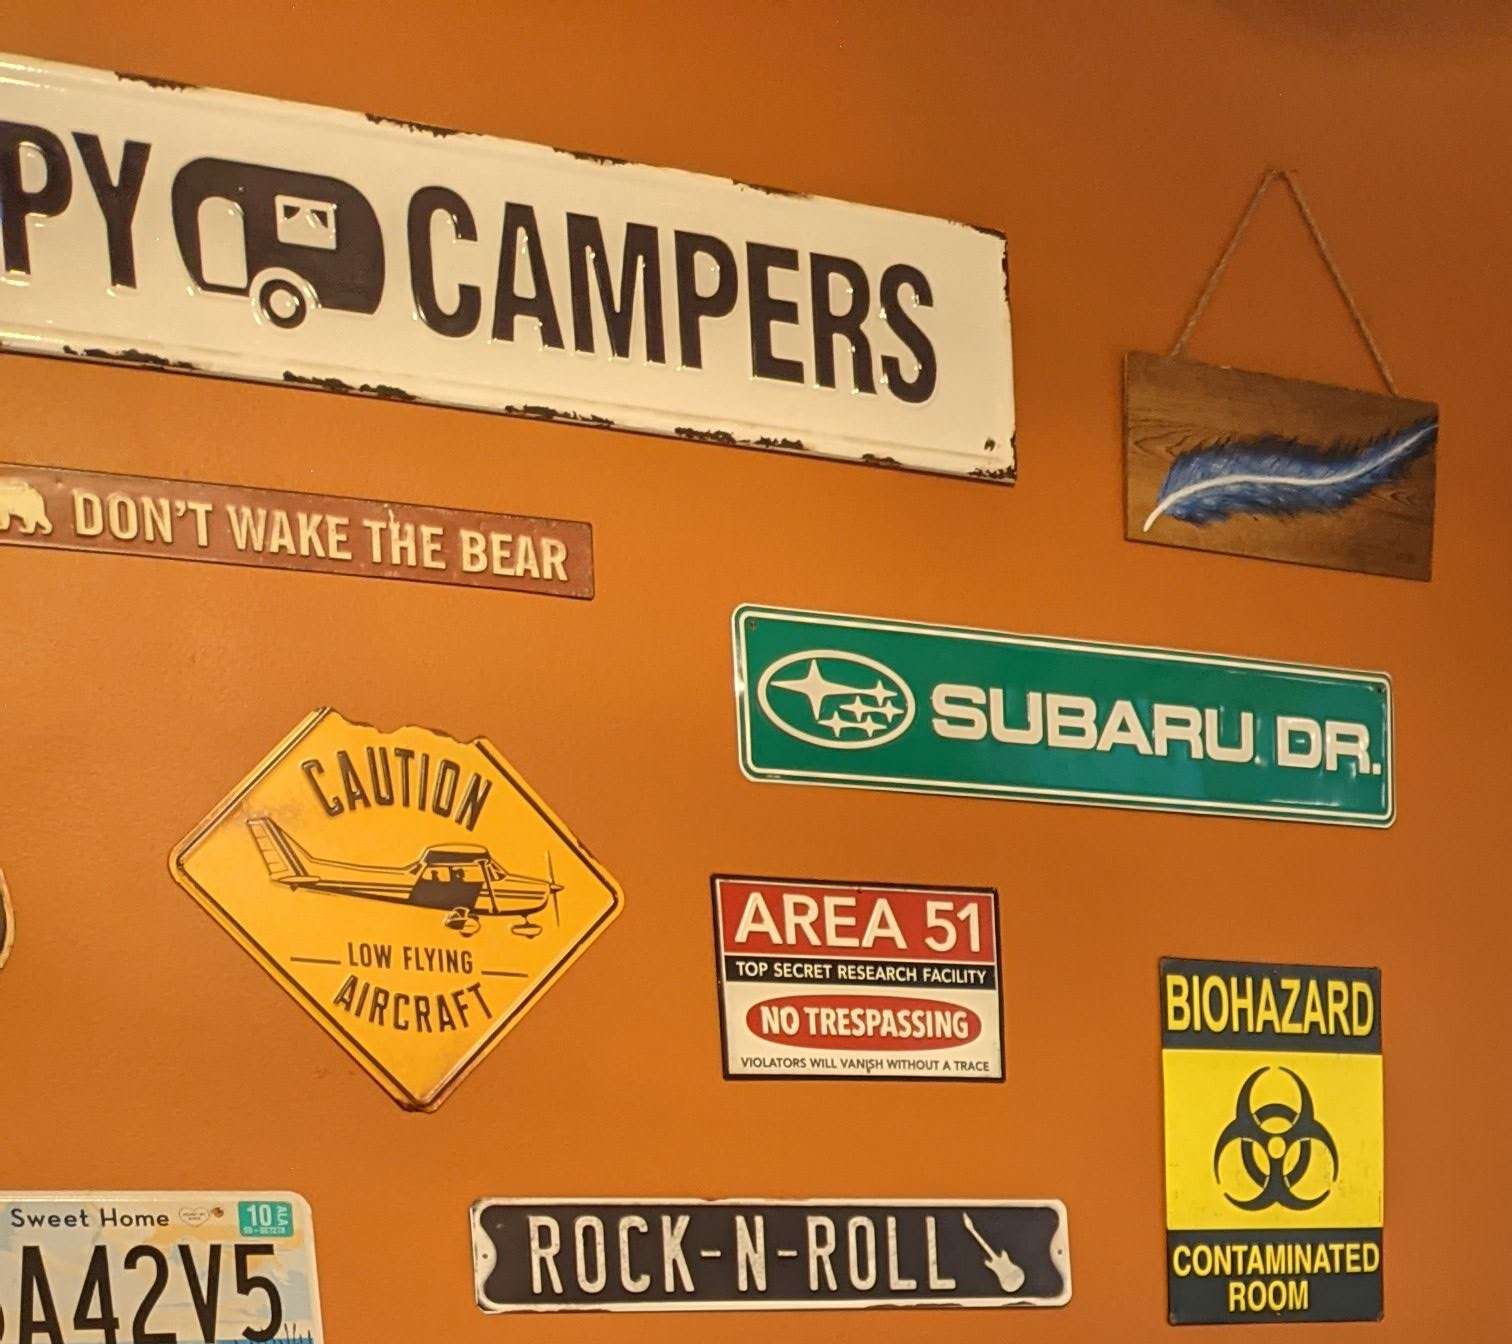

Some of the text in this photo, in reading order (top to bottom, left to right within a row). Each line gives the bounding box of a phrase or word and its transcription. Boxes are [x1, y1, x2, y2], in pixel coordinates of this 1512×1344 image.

[407, 185, 938, 404] CAMPERS
[72, 492, 568, 582] DON'T WAKE THE BEAR
[932, 683, 1382, 775] SUBARU DR.
[301, 746, 493, 832] CAUTION
[734, 891, 981, 953] AREA 51
[347, 941, 474, 975] LOW FLYING
[736, 960, 987, 985] TOP SECRET RESEARCH FACILITY
[333, 974, 493, 1034] AIRCRAFT
[760, 1005, 969, 1040] NO TRESPASSING
[1165, 973, 1375, 1037] BIOHAZARD
[741, 1056, 990, 1072] VIOLATORS WILL VANISH WITHOUT A TRACE
[10, 1207, 89, 1228] Sweet
[100, 1207, 170, 1228] Home
[246, 1204, 272, 1226] 10
[527, 1214, 957, 1295] ROCK-N-ROLL
[1172, 1242, 1381, 1278] CONTAMINATED
[1228, 1280, 1310, 1313] ROOM
